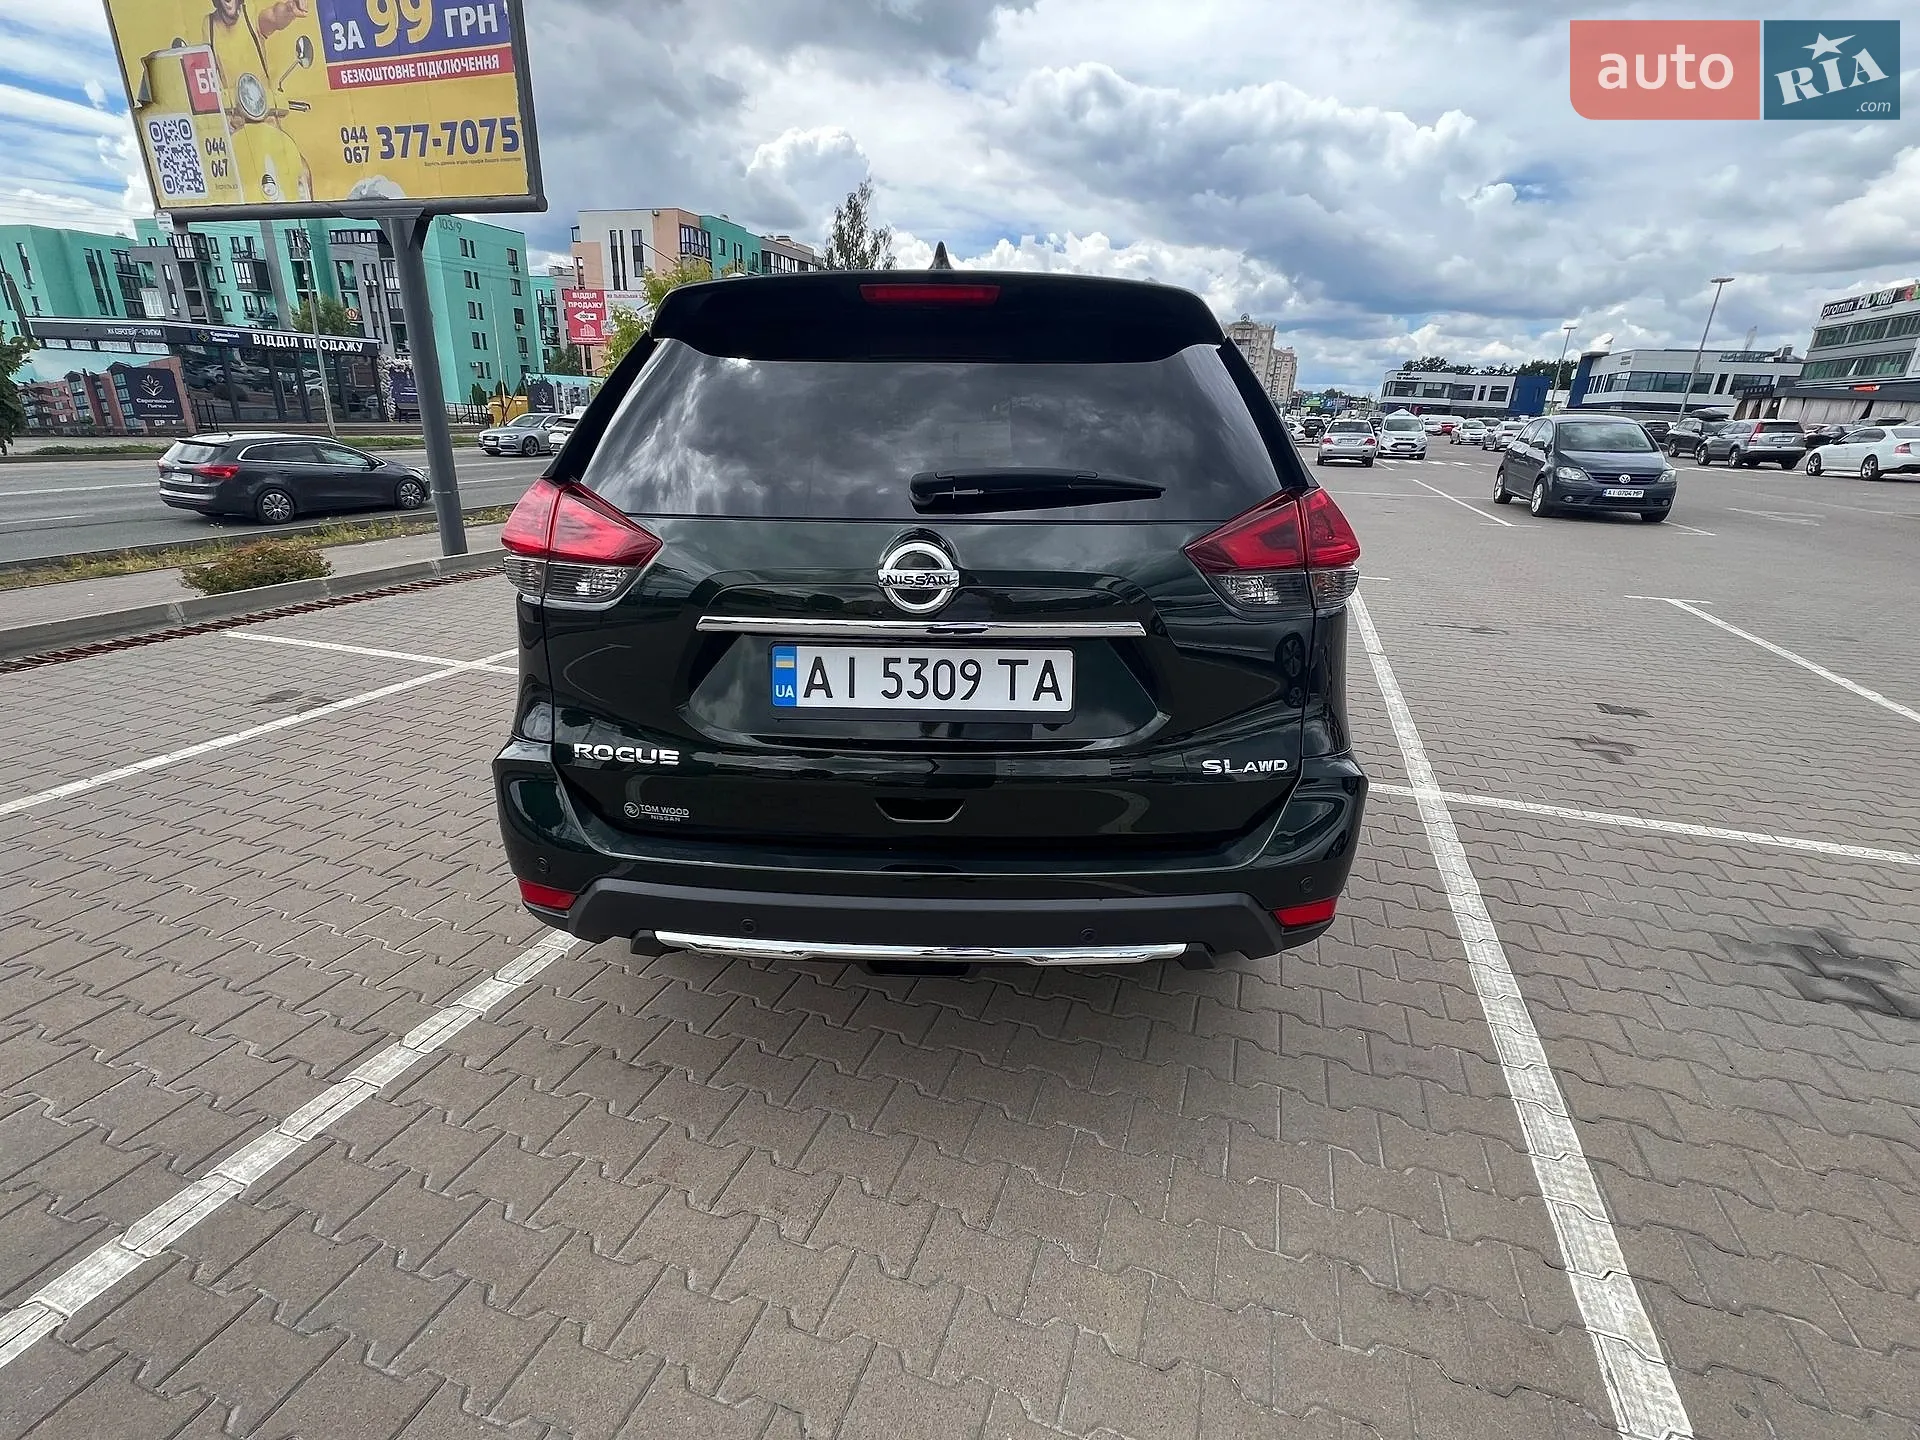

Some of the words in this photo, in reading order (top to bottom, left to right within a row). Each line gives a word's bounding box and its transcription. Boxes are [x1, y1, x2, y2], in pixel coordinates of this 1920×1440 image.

[330, 20, 366, 52] ЗА
[366, 0, 433, 47] 99
[444, 4, 498, 38] ГРН
[341, 63, 416, 85] БЕЗКОШТОВНЕ
[416, 54, 500, 79] ПІДКЛЮЧЕННЯ
[340, 126, 368, 145] 044
[376, 116, 520, 160] 377-7075
[205, 137, 227, 156] 044
[344, 145, 370, 164] 067
[211, 159, 228, 178] 067
[568, 301, 604, 310] ПРОДАЖУ
[572, 292, 597, 300] ВІДДІЛ
[252, 333, 299, 348] ВІДДІЛ
[887, 573, 951, 586] NISSAN
[803, 656, 856, 699] AI
[880, 657, 982, 701] 5309
[997, 658, 1063, 702] TA
[775, 685, 795, 698] UA
[573, 743, 680, 766] ROGUE
[639, 803, 660, 813] TOM
[660, 806, 690, 816] WOOD
[650, 814, 681, 823] NISSAN
